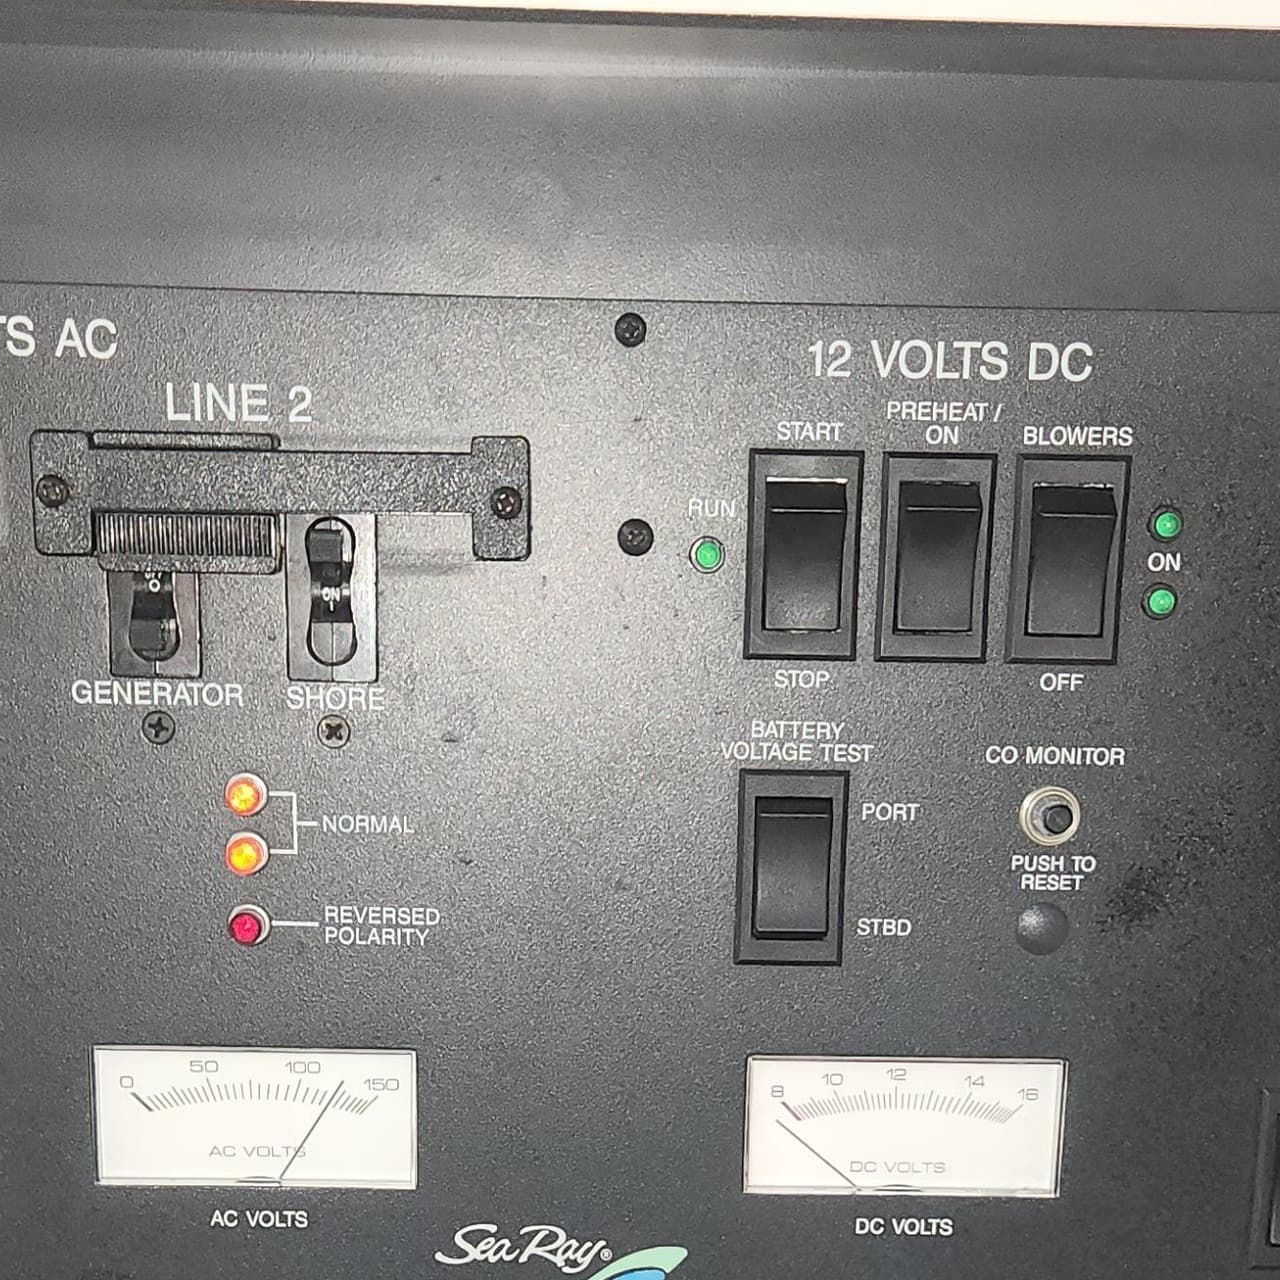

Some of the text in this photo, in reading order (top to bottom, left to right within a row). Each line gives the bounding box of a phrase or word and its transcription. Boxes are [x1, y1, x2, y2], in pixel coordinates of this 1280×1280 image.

[55, 318, 117, 359] AC
[807, 340, 1092, 381] 12 VOLTS DC
[167, 381, 316, 426] LINE 2
[887, 401, 988, 421] PREHEAT
[776, 421, 844, 442] START
[926, 425, 958, 444] ON
[1024, 425, 1132, 446] BLOWERS
[686, 497, 736, 522] RUN
[1148, 553, 1180, 571] ON
[775, 670, 830, 692] STOP
[1040, 673, 1084, 691] OFF
[750, 718, 845, 744] BATTERY
[721, 741, 874, 765] VOLTAGE TEST
[986, 746, 1125, 765] CO MONITOR
[1012, 855, 1096, 872] PUSH TO
[1021, 874, 1084, 890] RESET
[771, 1068, 1040, 1101] 8 10 12 14 16
[856, 1218, 952, 1235] DC VOLTS
